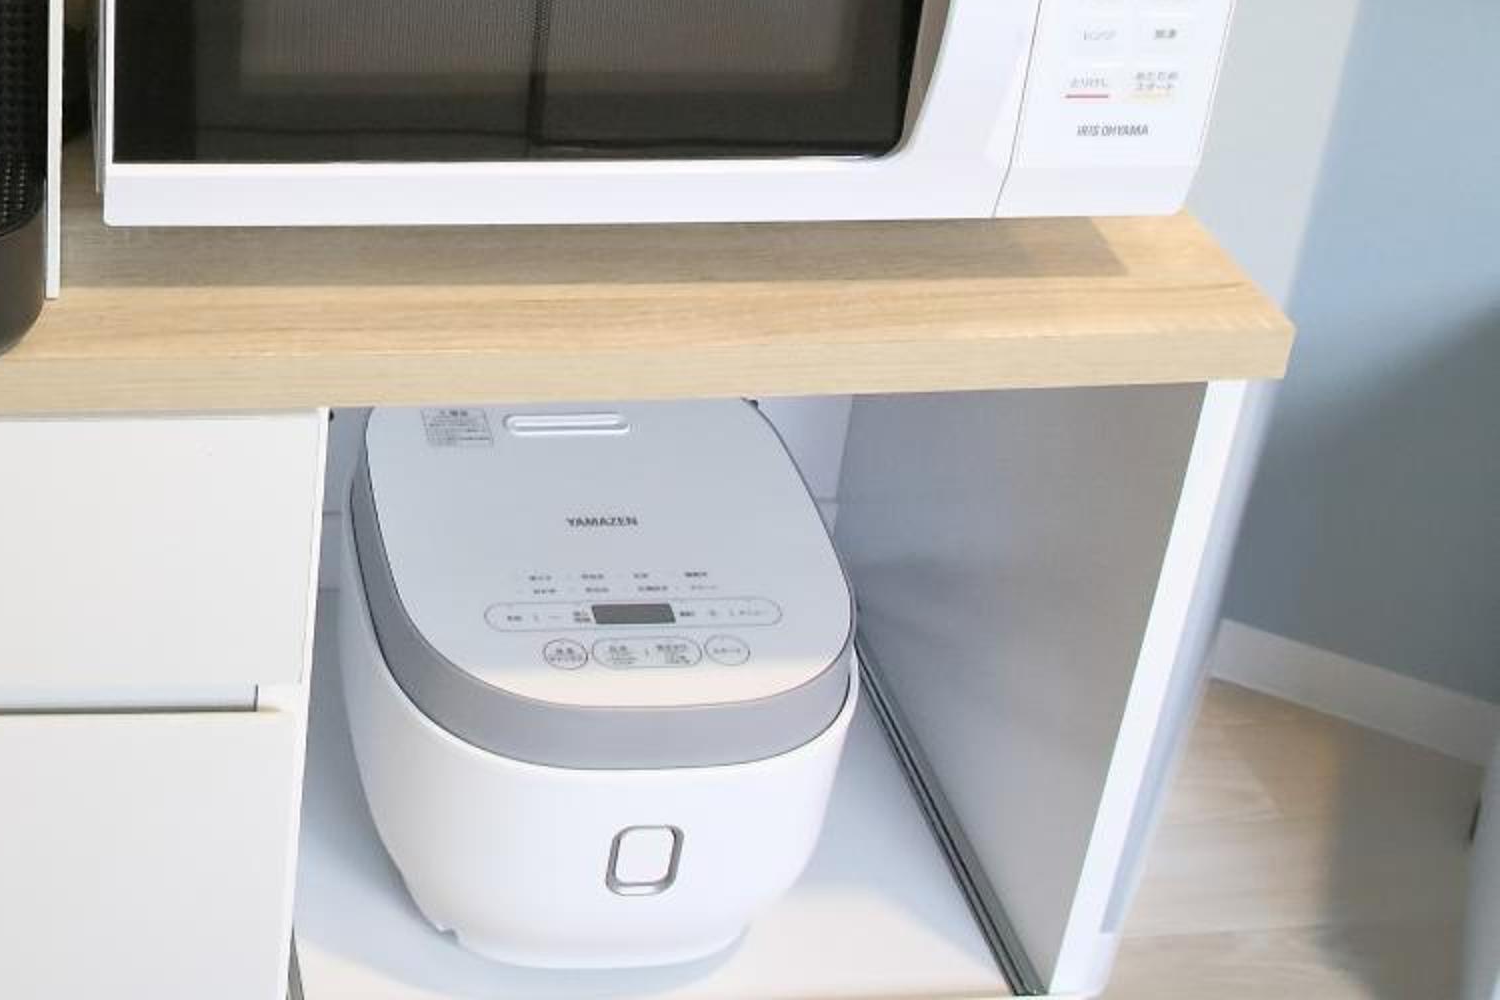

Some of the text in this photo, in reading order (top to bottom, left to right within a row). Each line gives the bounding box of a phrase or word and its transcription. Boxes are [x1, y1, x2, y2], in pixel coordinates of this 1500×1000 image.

[1076, 123, 1149, 137] IRIS OHYAMA
[566, 516, 638, 527] YAMAZEN
